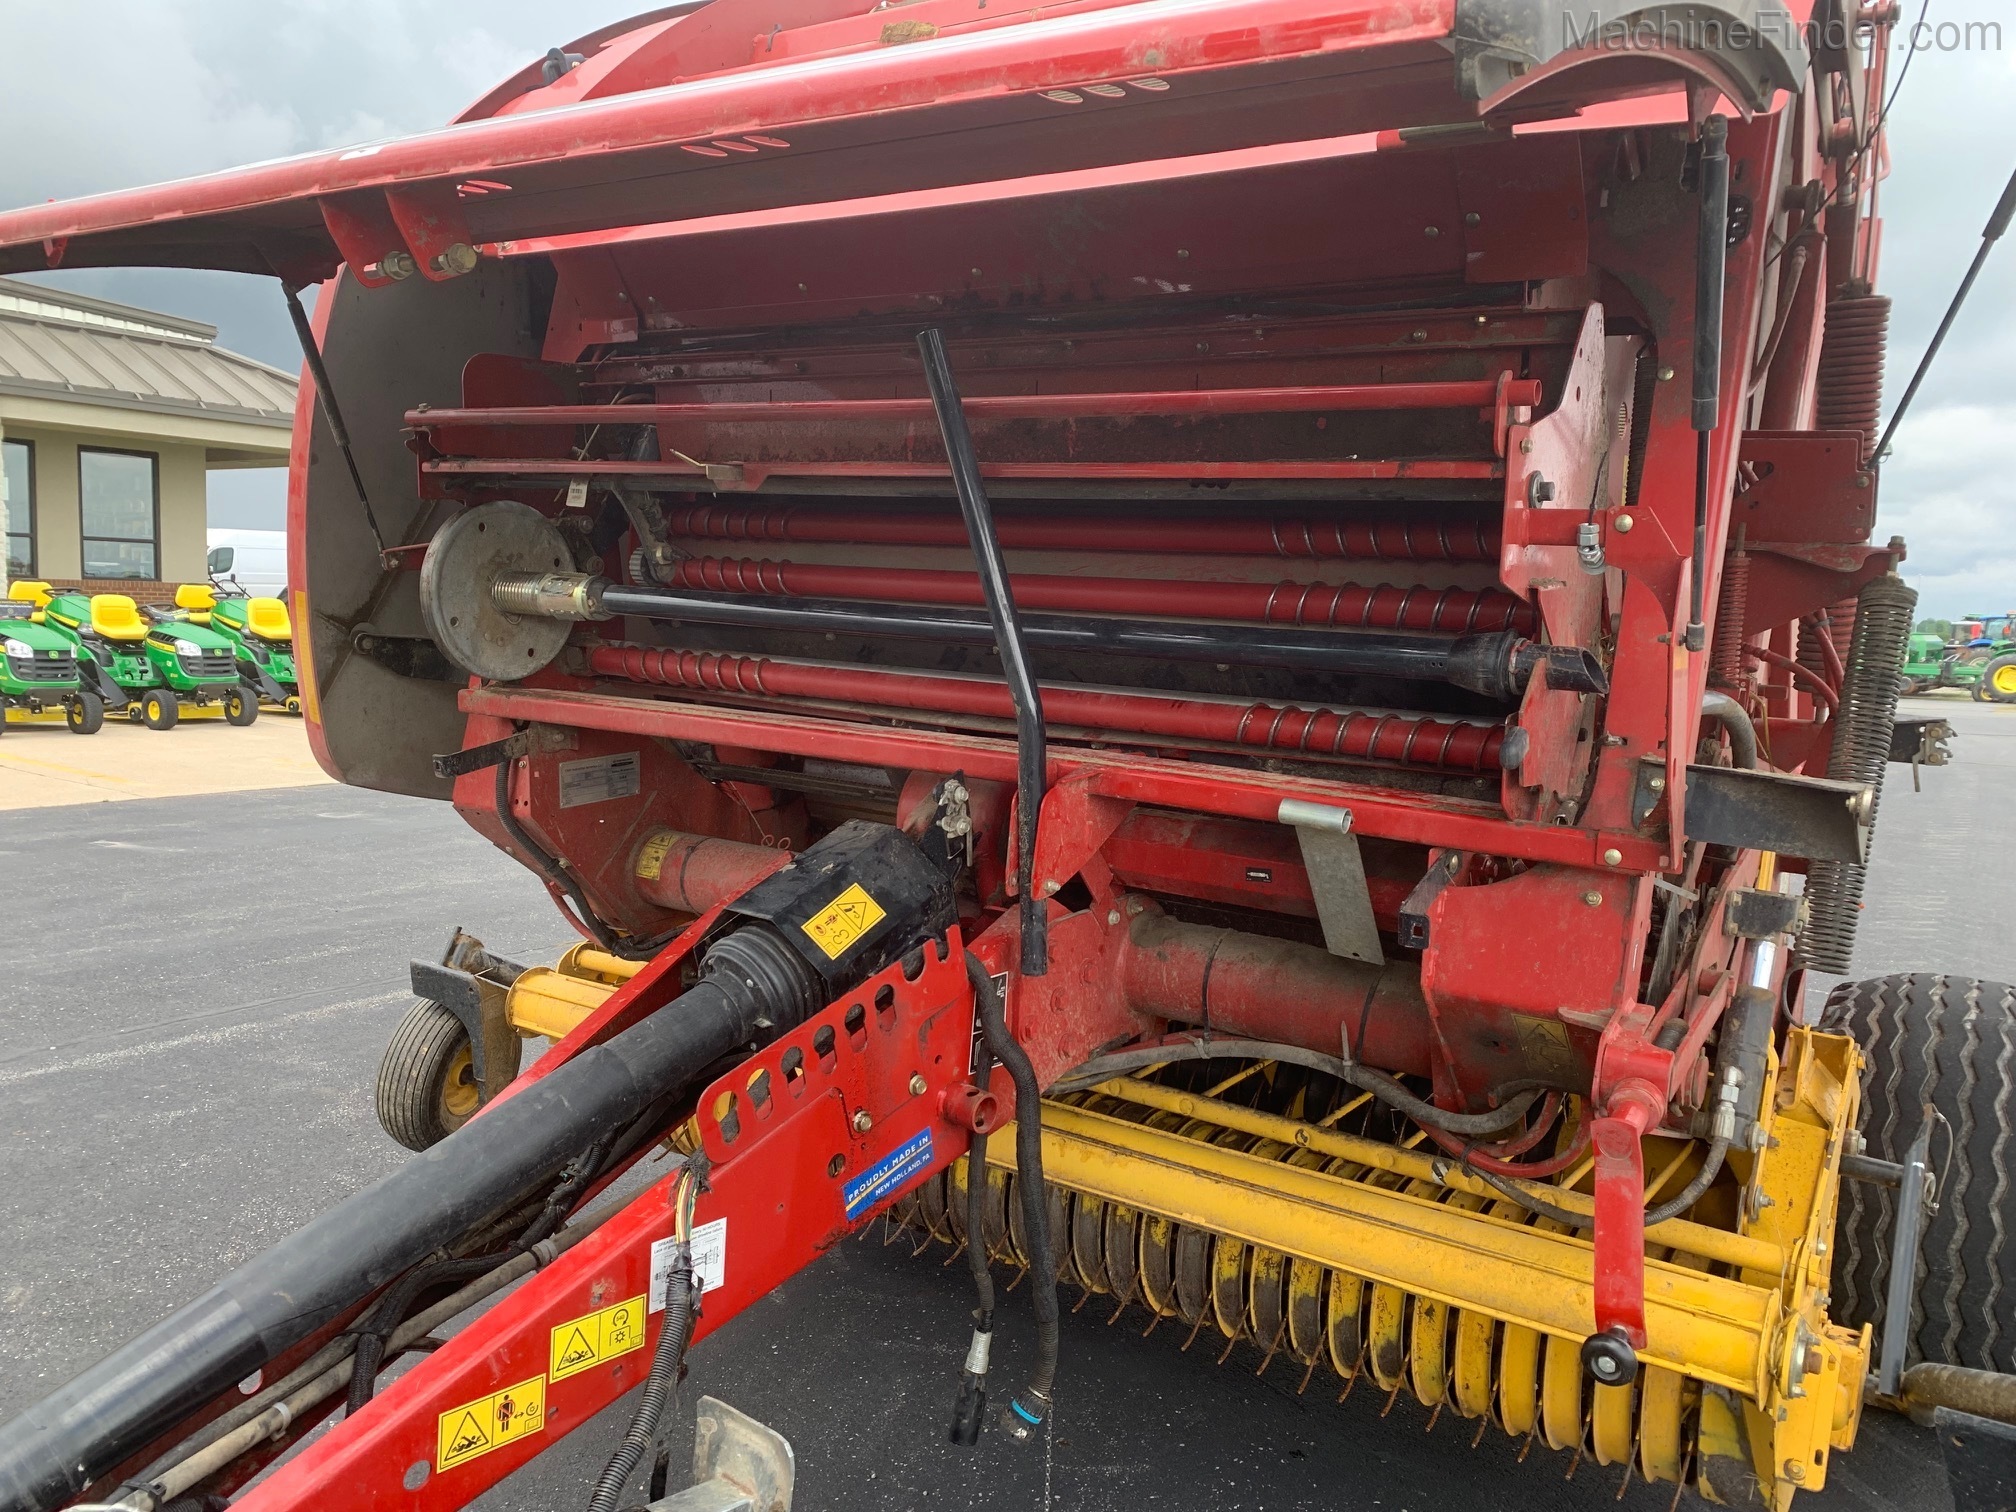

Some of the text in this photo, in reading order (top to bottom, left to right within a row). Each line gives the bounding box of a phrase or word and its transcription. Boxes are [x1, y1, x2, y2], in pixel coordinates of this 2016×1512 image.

[848, 1135, 929, 1202] PROUDLY MADE IN
[875, 1182, 890, 1196] NEW
